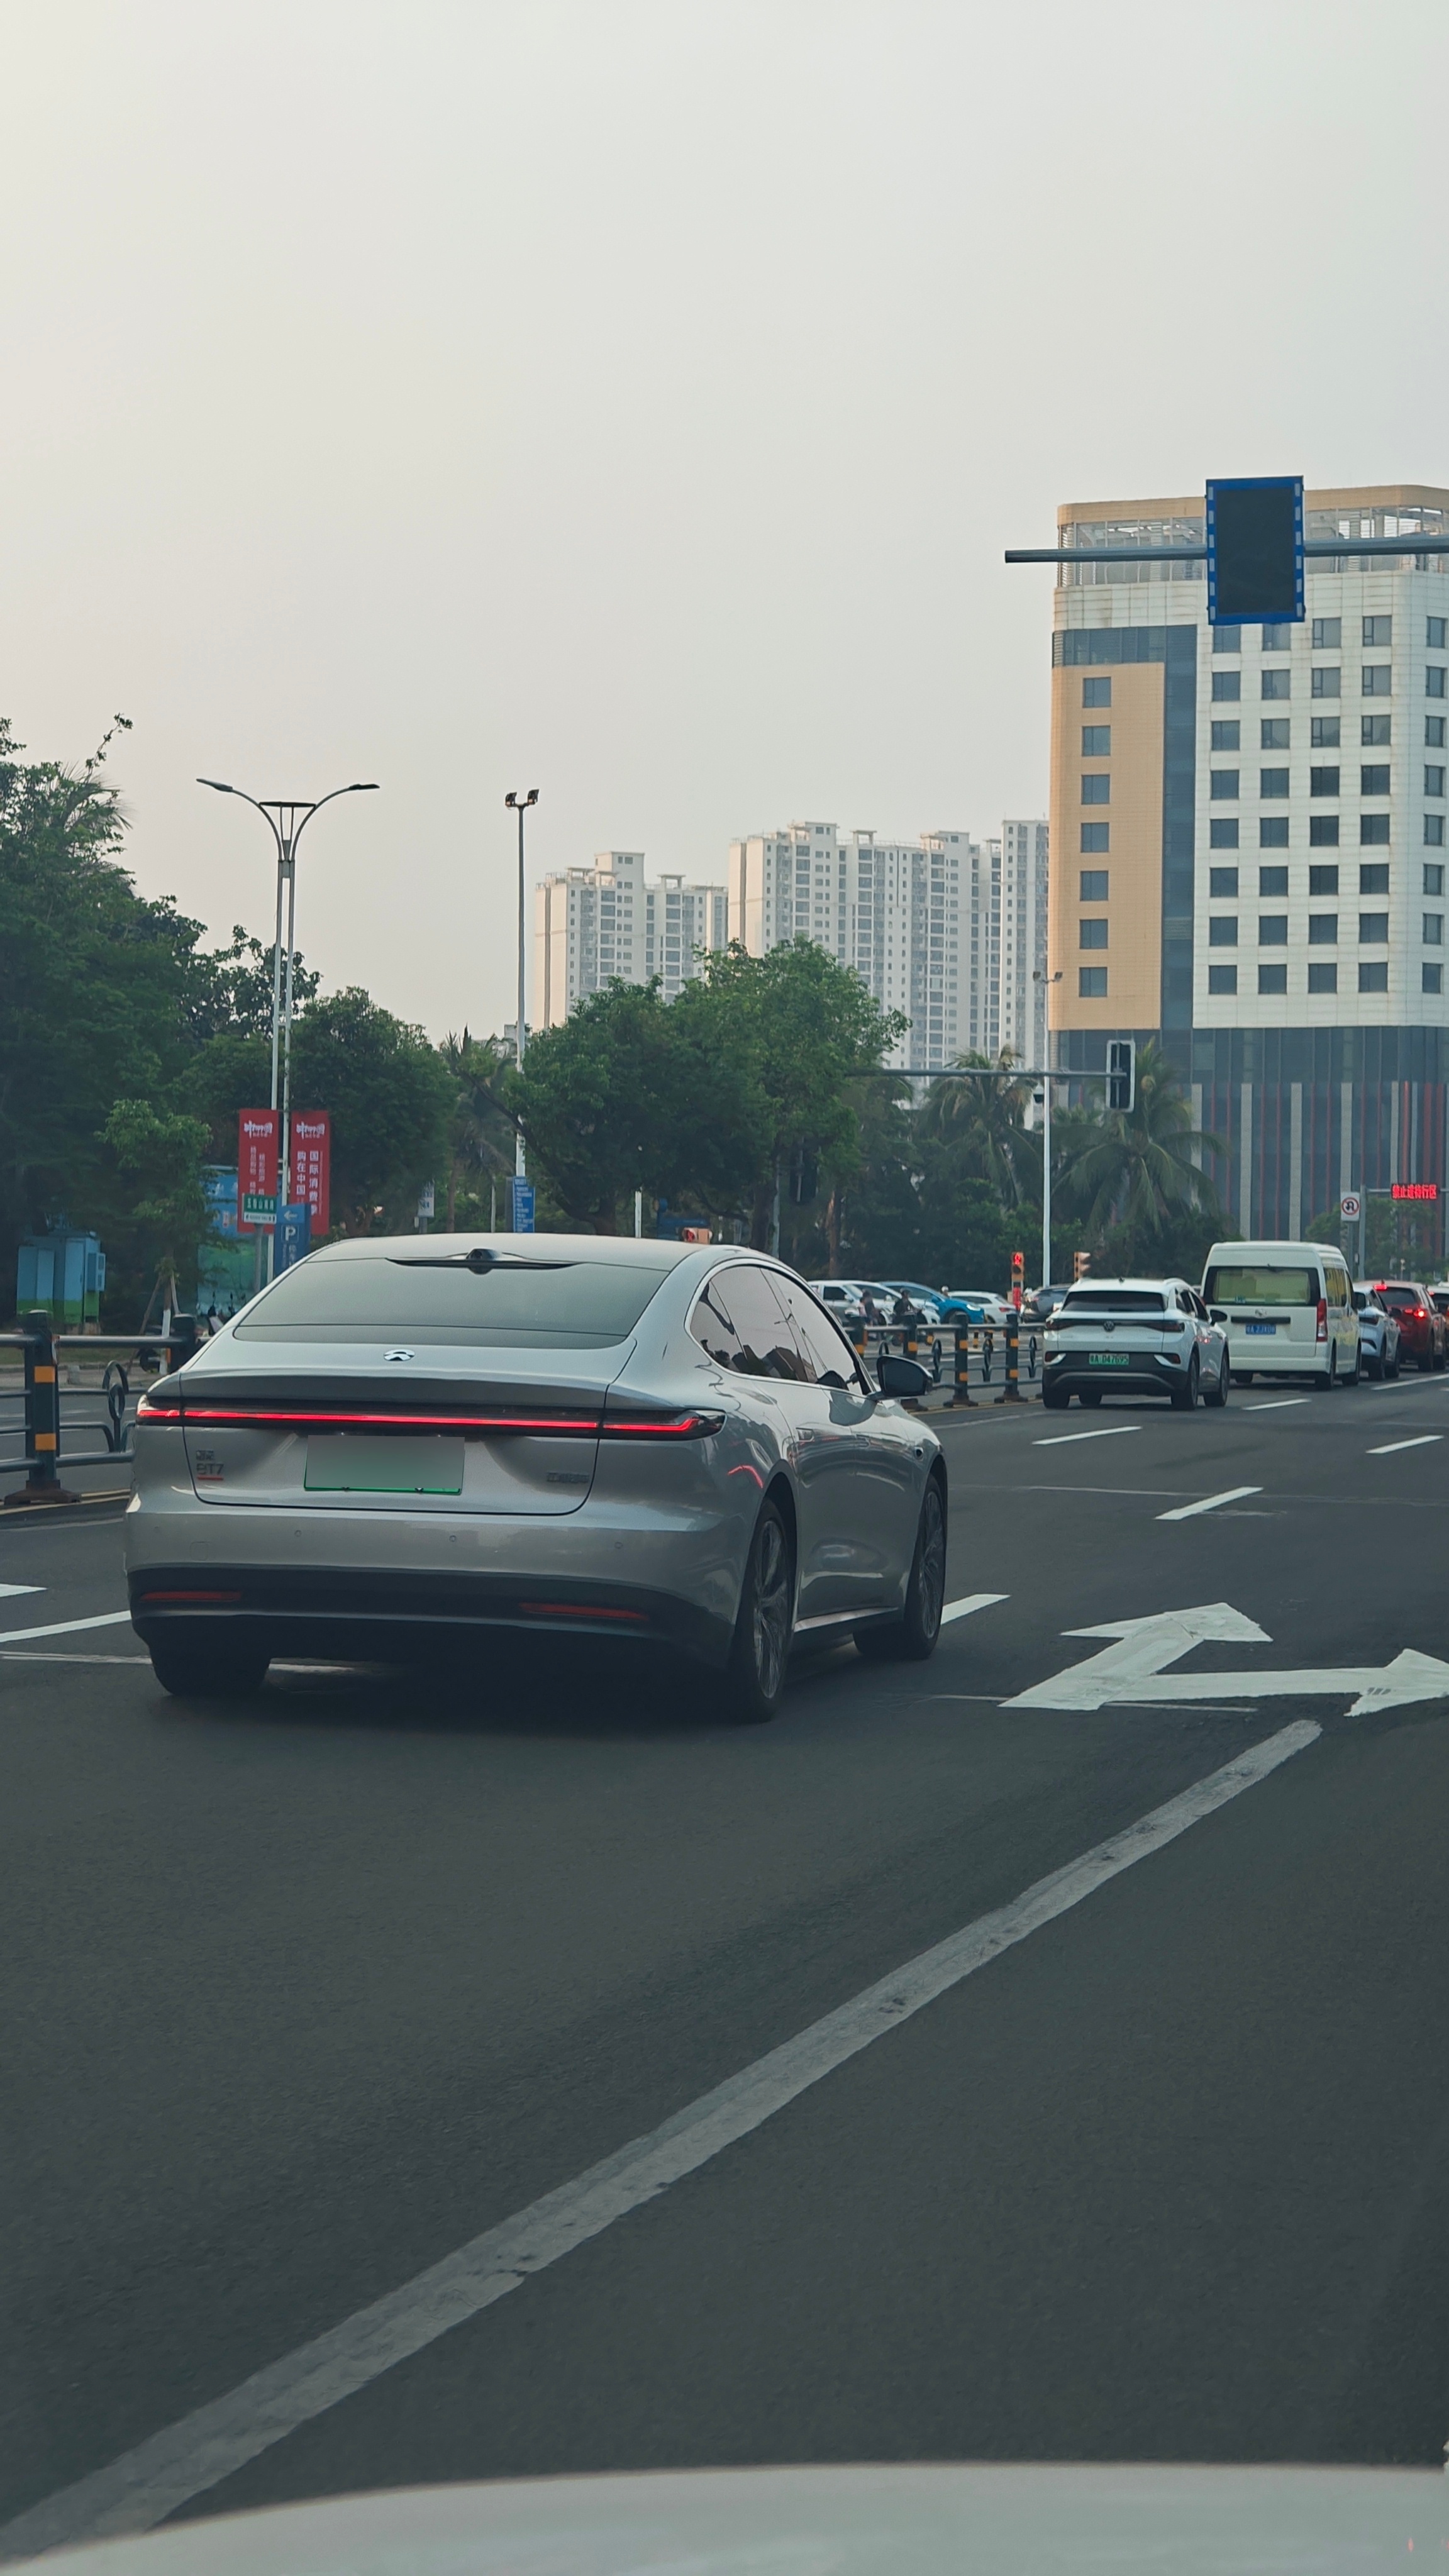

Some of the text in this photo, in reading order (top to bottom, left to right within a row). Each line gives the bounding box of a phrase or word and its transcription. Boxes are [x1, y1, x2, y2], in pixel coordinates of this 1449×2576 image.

[296, 1151, 306, 1195] 购在中国
[285, 1226, 296, 1241] P
